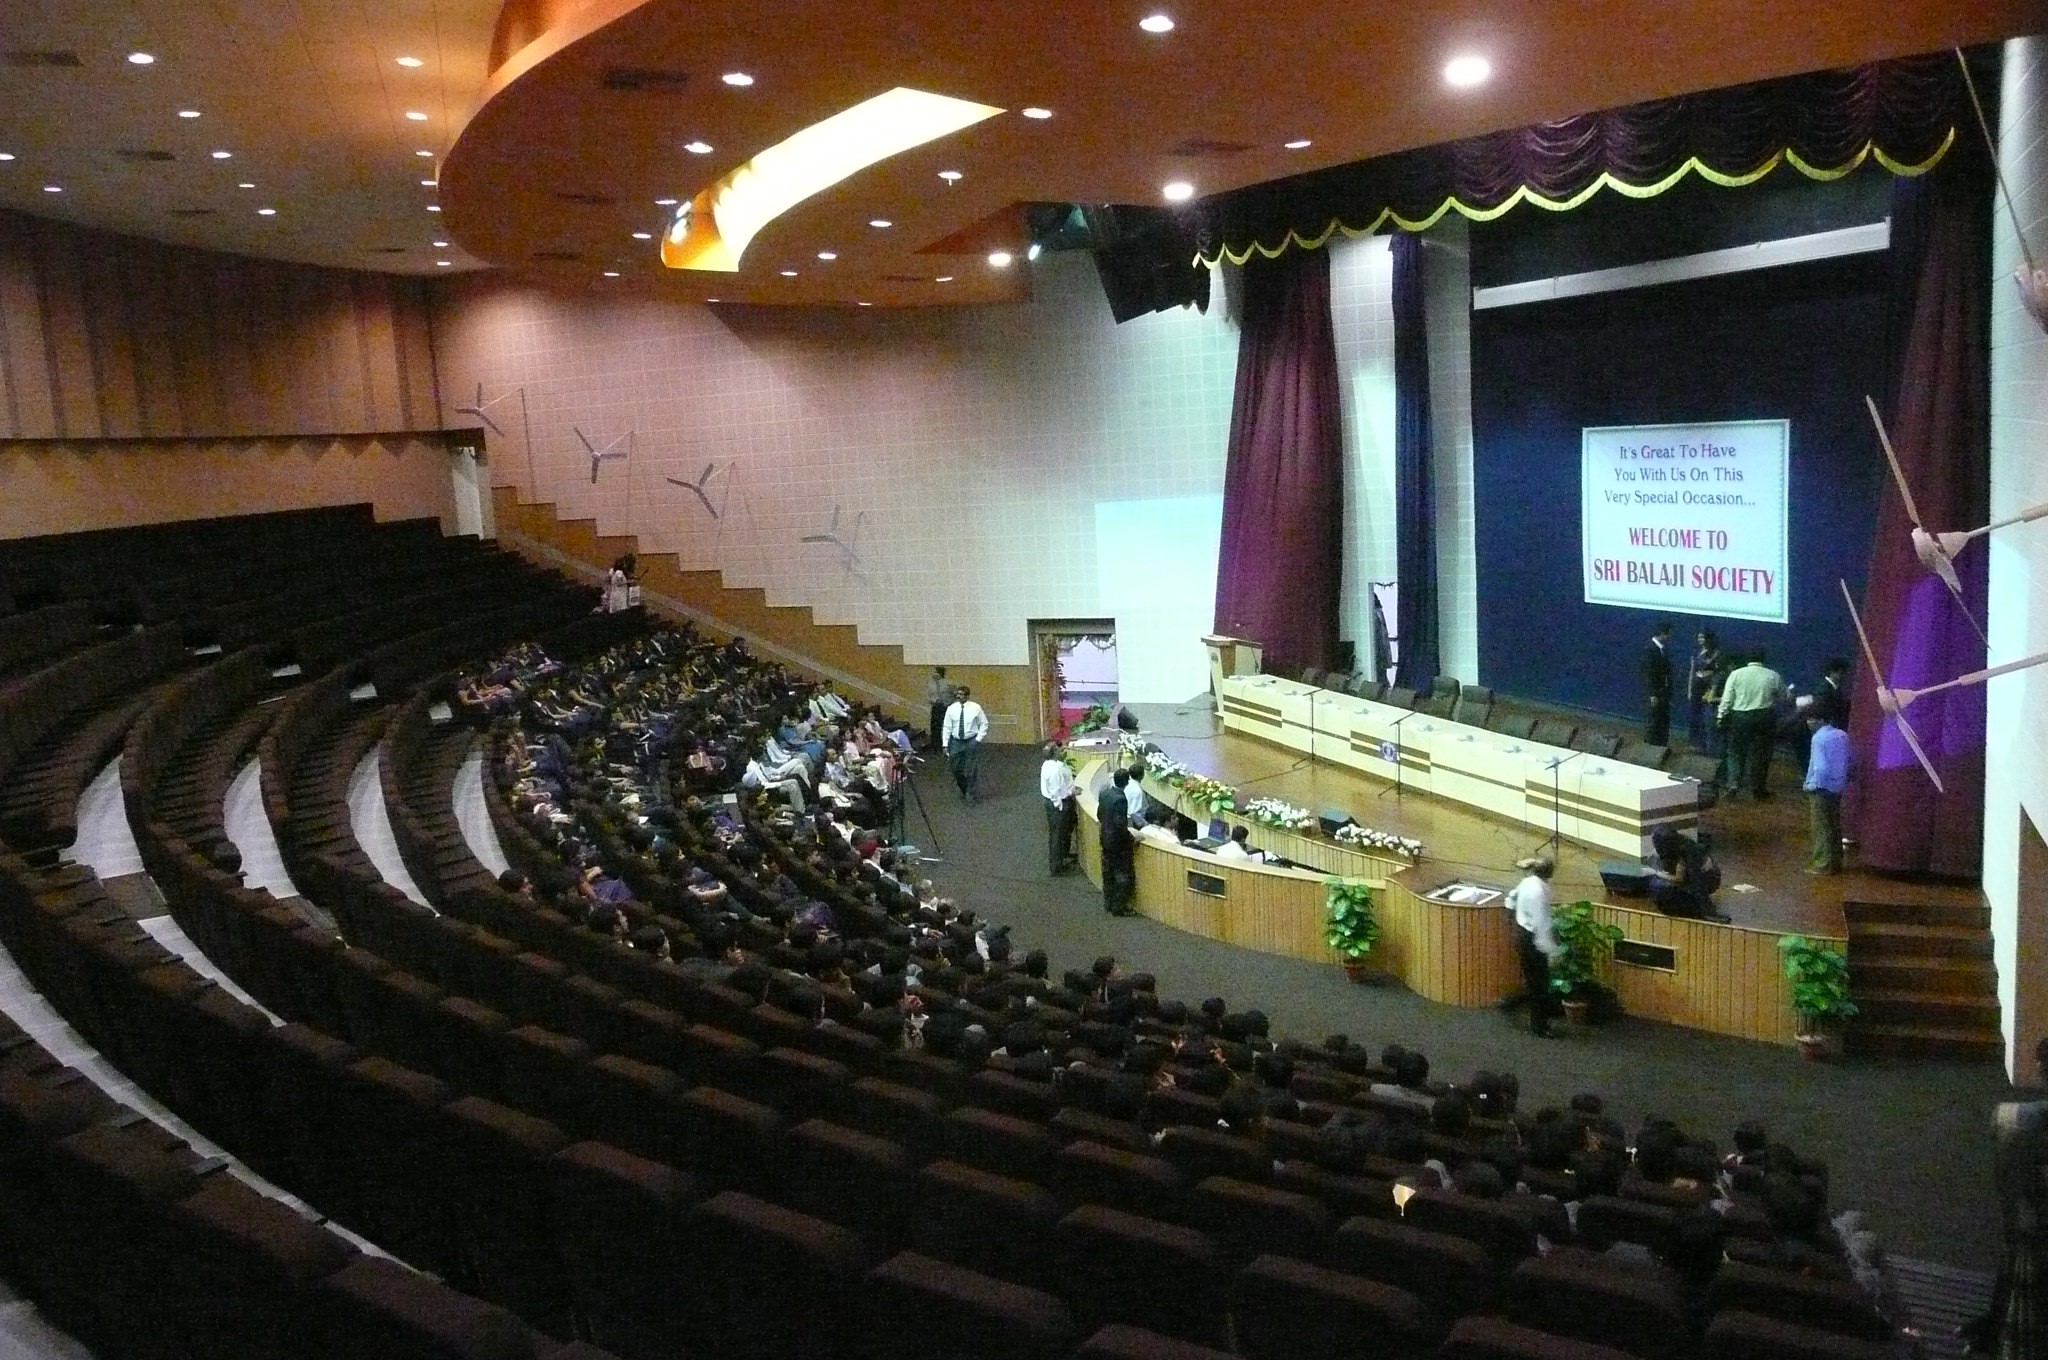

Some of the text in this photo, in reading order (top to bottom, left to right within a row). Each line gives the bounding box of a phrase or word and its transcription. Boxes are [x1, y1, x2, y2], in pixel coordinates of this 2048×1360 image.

[1620, 444, 1736, 459] It's Great To Have
[1614, 467, 1743, 481] You With Us On This
[1605, 490, 1755, 506] Very Special Occasion...
[1629, 528, 1727, 550] WELCOME TO
[1594, 559, 1774, 594] SRI BALAJI SOCIETY
